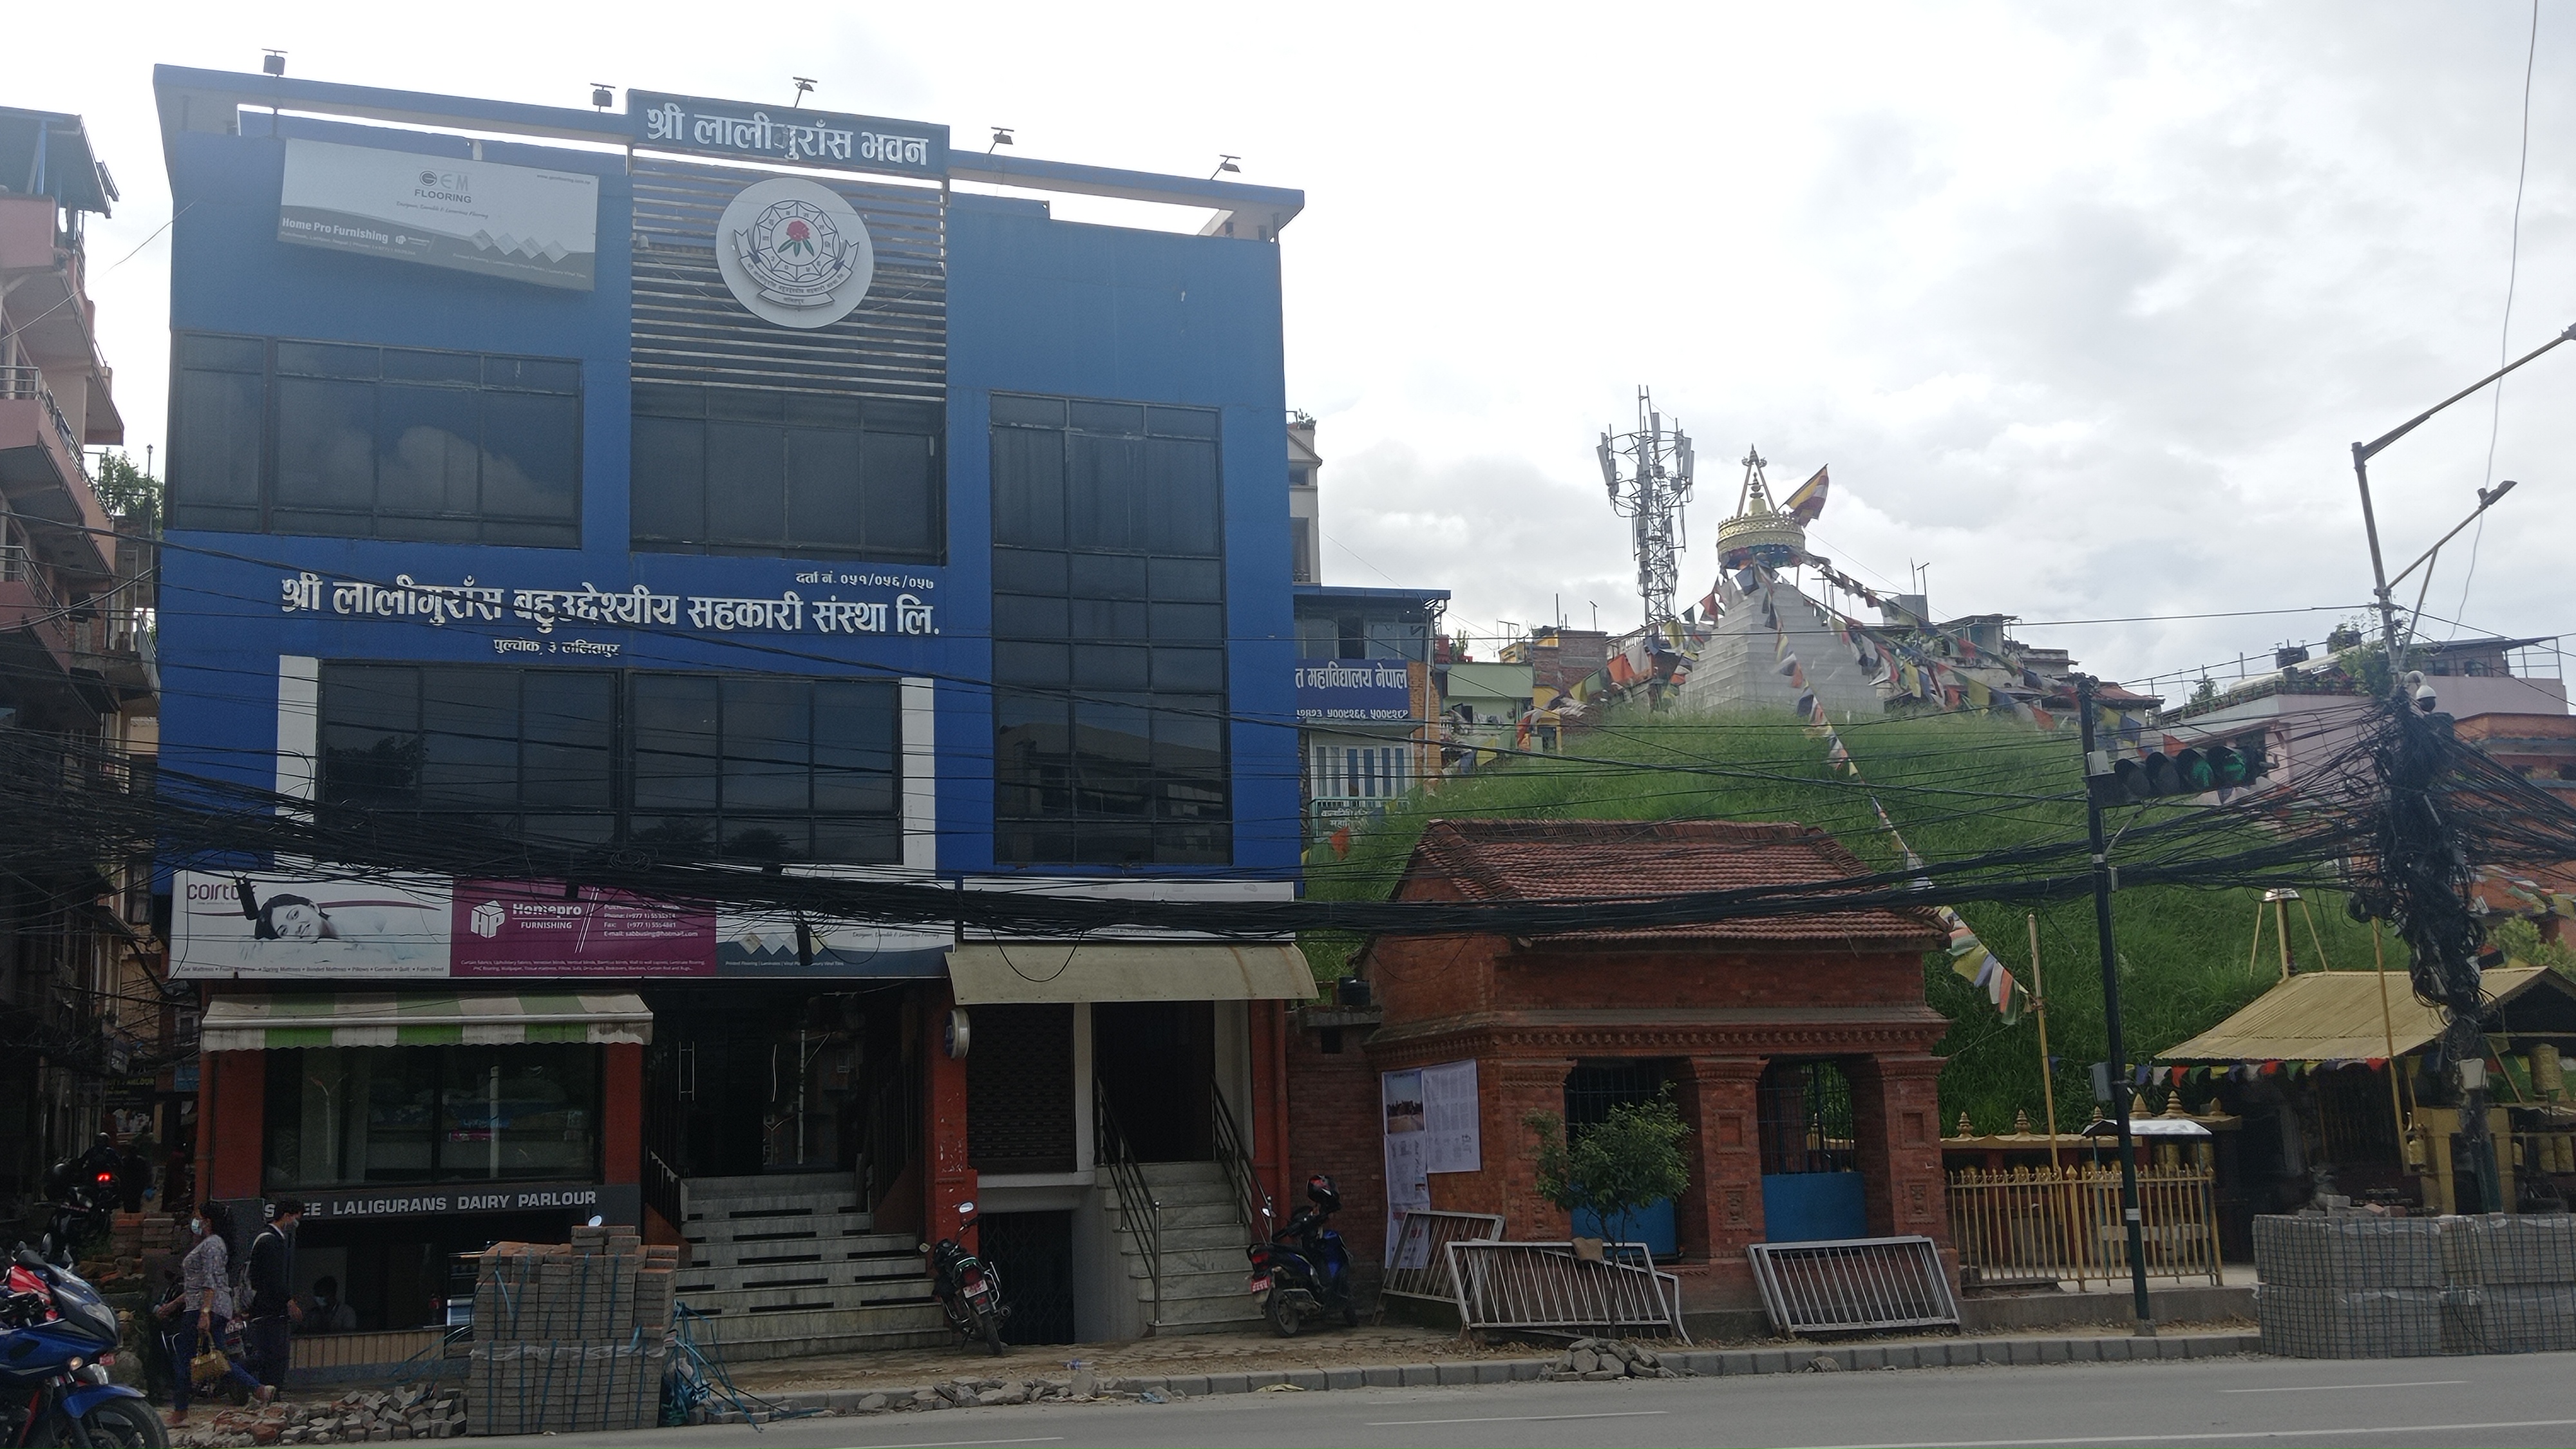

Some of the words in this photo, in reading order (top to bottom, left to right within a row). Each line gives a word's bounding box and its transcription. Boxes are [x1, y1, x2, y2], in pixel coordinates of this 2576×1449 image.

[647, 102, 685, 140] श्री
[860, 131, 929, 166] भवन
[414, 189, 472, 204] FLOORING
[282, 217, 312, 231] Home
[314, 221, 331, 234] Pro
[334, 225, 389, 244] Furnishing
[795, 571, 819, 584] दर्ता
[282, 571, 323, 612] श्री
[687, 590, 803, 630] सहकारी
[813, 595, 888, 635] संस्था
[896, 593, 940, 636] लि.
[547, 641, 556, 654] ३
[1307, 660, 1372, 690] महाविद्यालय
[1375, 662, 1408, 689] नेपाल
[513, 904, 583, 918] Homepro
[332, 1197, 447, 1216] LALIGURANS
[458, 1195, 511, 1210] DAIRY
[517, 1191, 596, 1207] PARLOUR
